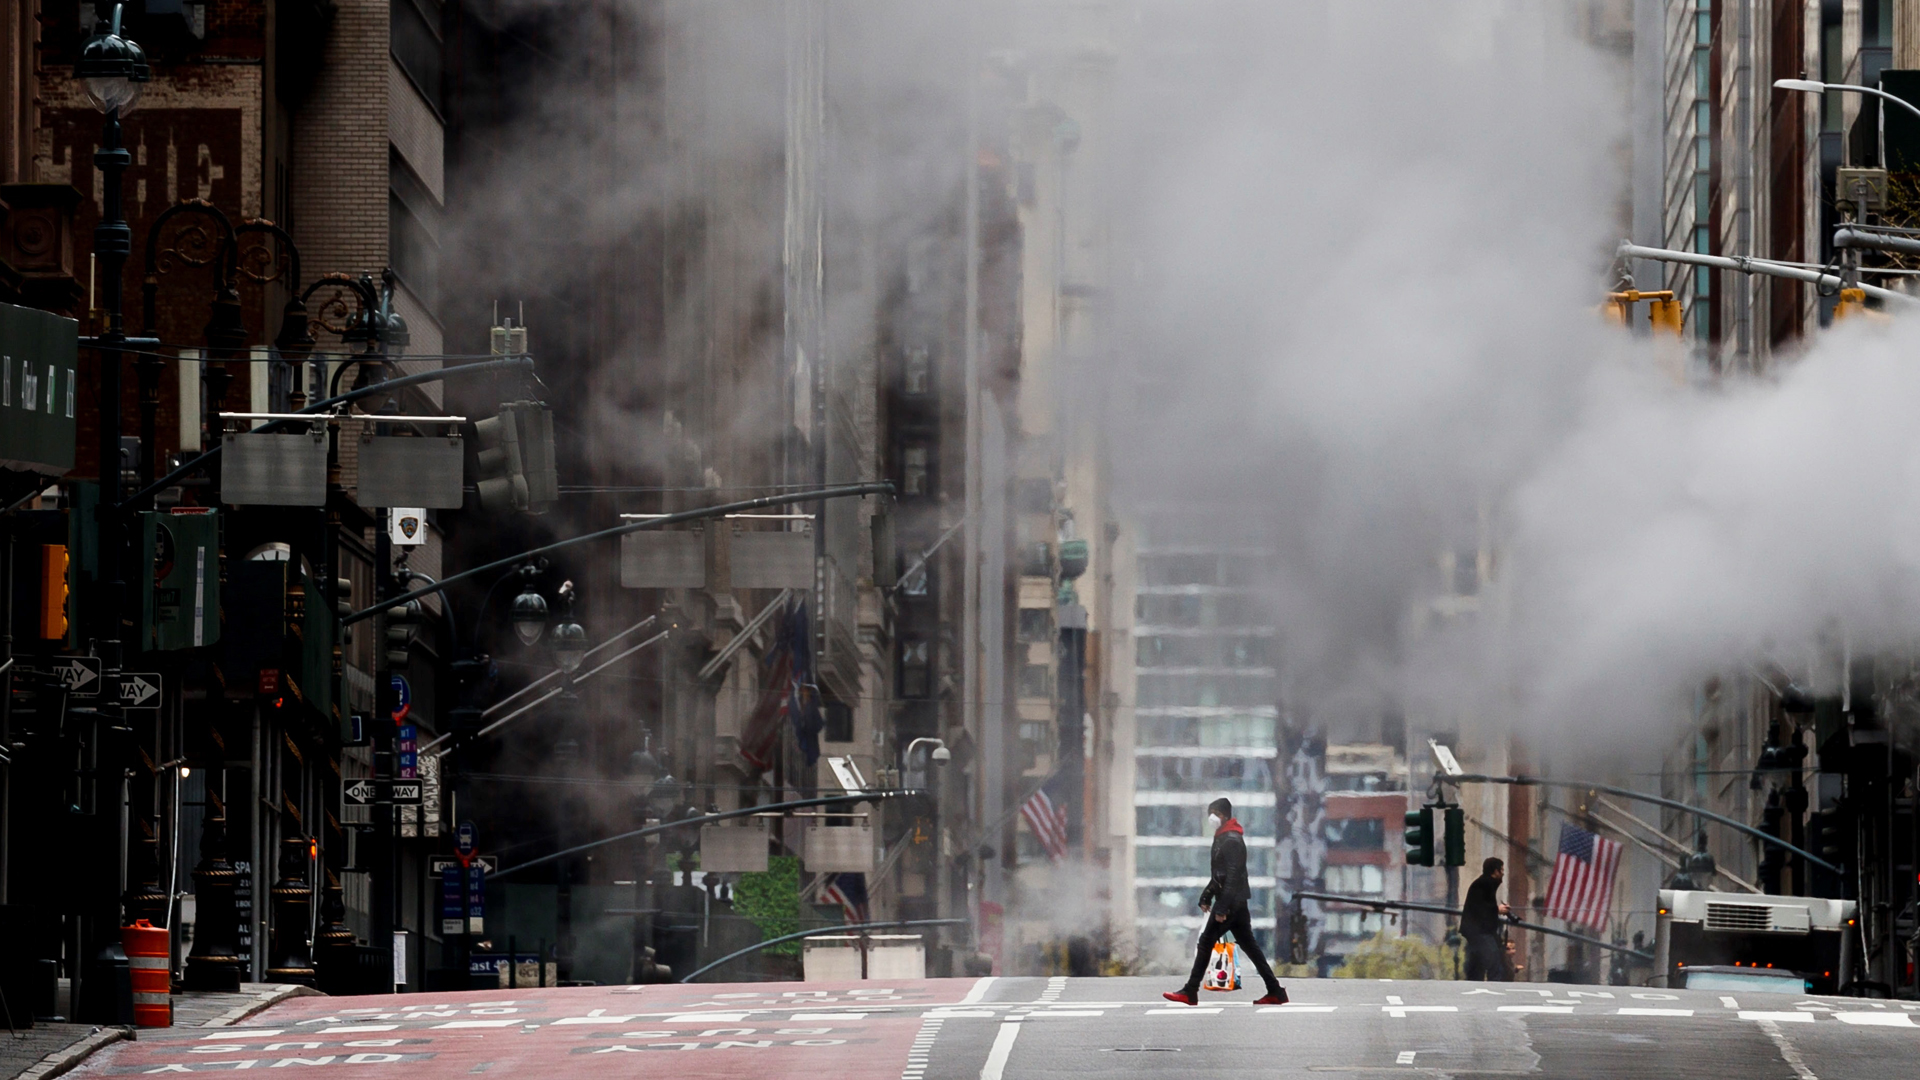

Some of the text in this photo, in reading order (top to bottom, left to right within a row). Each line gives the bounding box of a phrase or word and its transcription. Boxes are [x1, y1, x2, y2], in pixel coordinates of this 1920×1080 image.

[352, 786, 416, 798] ONE WAY
[1462, 988, 1680, 1001] ONLY
[296, 1007, 518, 1026] ONLY
[622, 1027, 833, 1038] BUS
[187, 1038, 404, 1053] BUS
[593, 1039, 847, 1053] ONLY
[142, 1054, 402, 1074] ONLY
